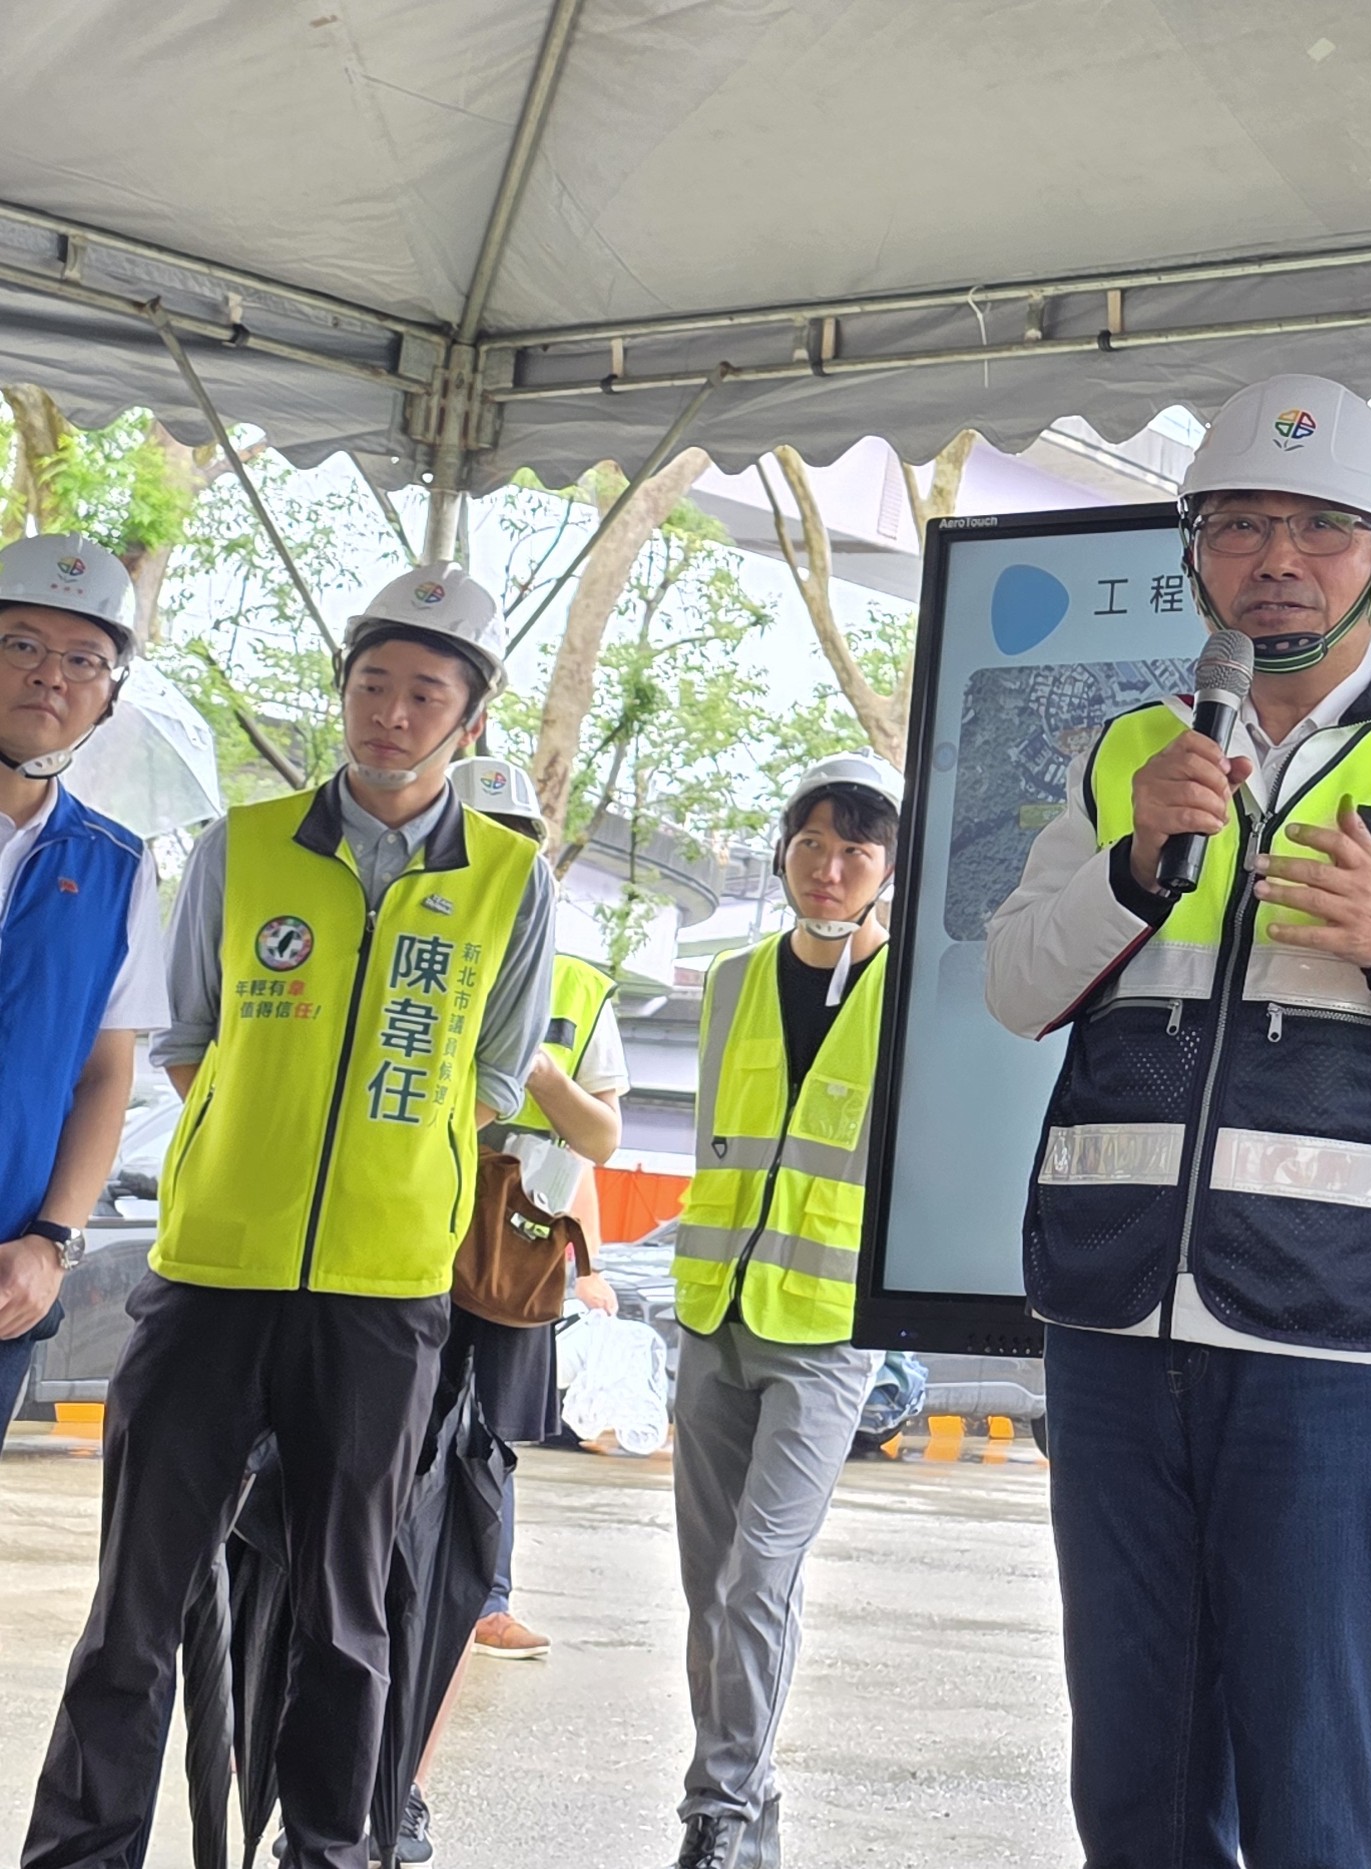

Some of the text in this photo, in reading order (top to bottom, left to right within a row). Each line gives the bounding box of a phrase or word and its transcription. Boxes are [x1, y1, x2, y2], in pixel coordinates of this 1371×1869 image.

[939, 517, 998, 529] AeroTouch
[1094, 574, 1183, 615] 工程
[368, 934, 454, 1124] 陳韋任
